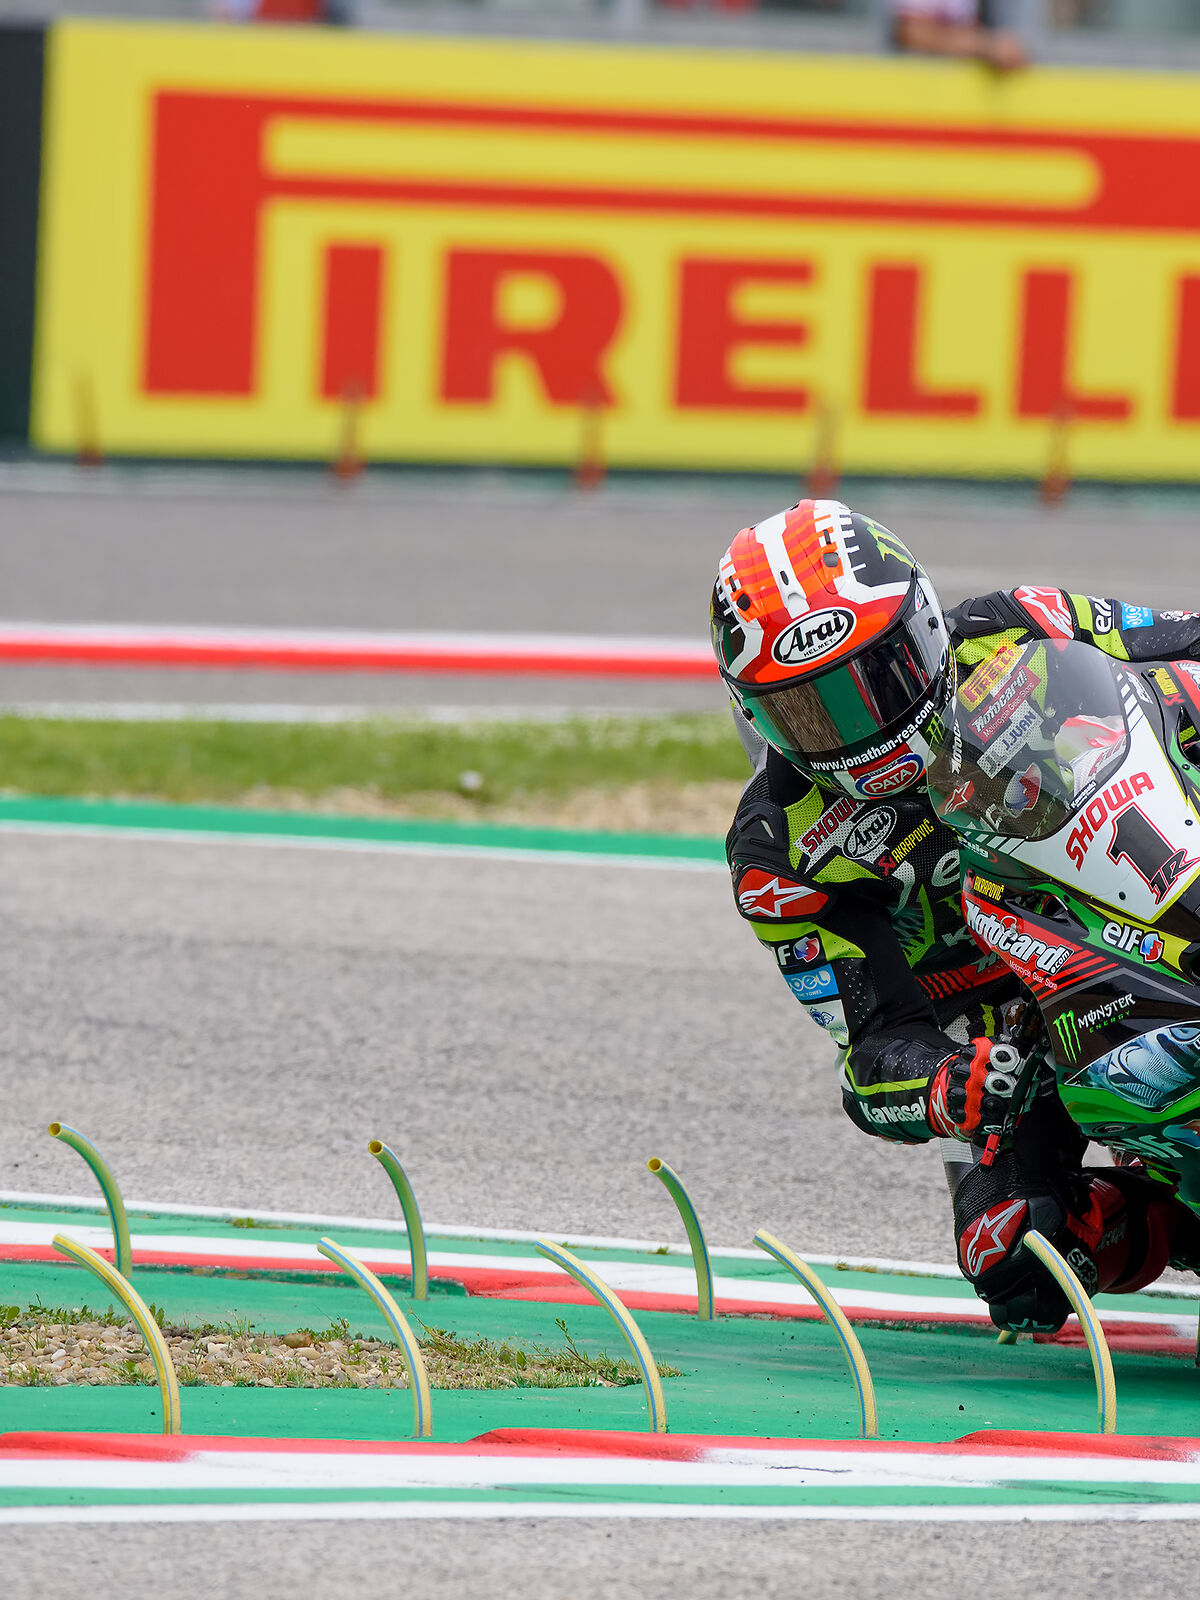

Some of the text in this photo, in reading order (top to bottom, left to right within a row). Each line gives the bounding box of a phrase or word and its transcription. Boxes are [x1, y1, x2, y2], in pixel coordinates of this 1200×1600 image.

[782, 611, 845, 661] Arai
[810, 699, 935, 772] www.jonathan-rea.com
[1001, 711, 1037, 751] J.JUAN
[870, 769, 913, 792] PATA
[852, 811, 890, 857] Arai
[1066, 771, 1155, 872] SHOWA
[1102, 922, 1144, 953] elf
[1077, 993, 1136, 1028] MONSTER
[1089, 1010, 1131, 1033] ENERGY
[860, 1097, 927, 1124] Kawasa
